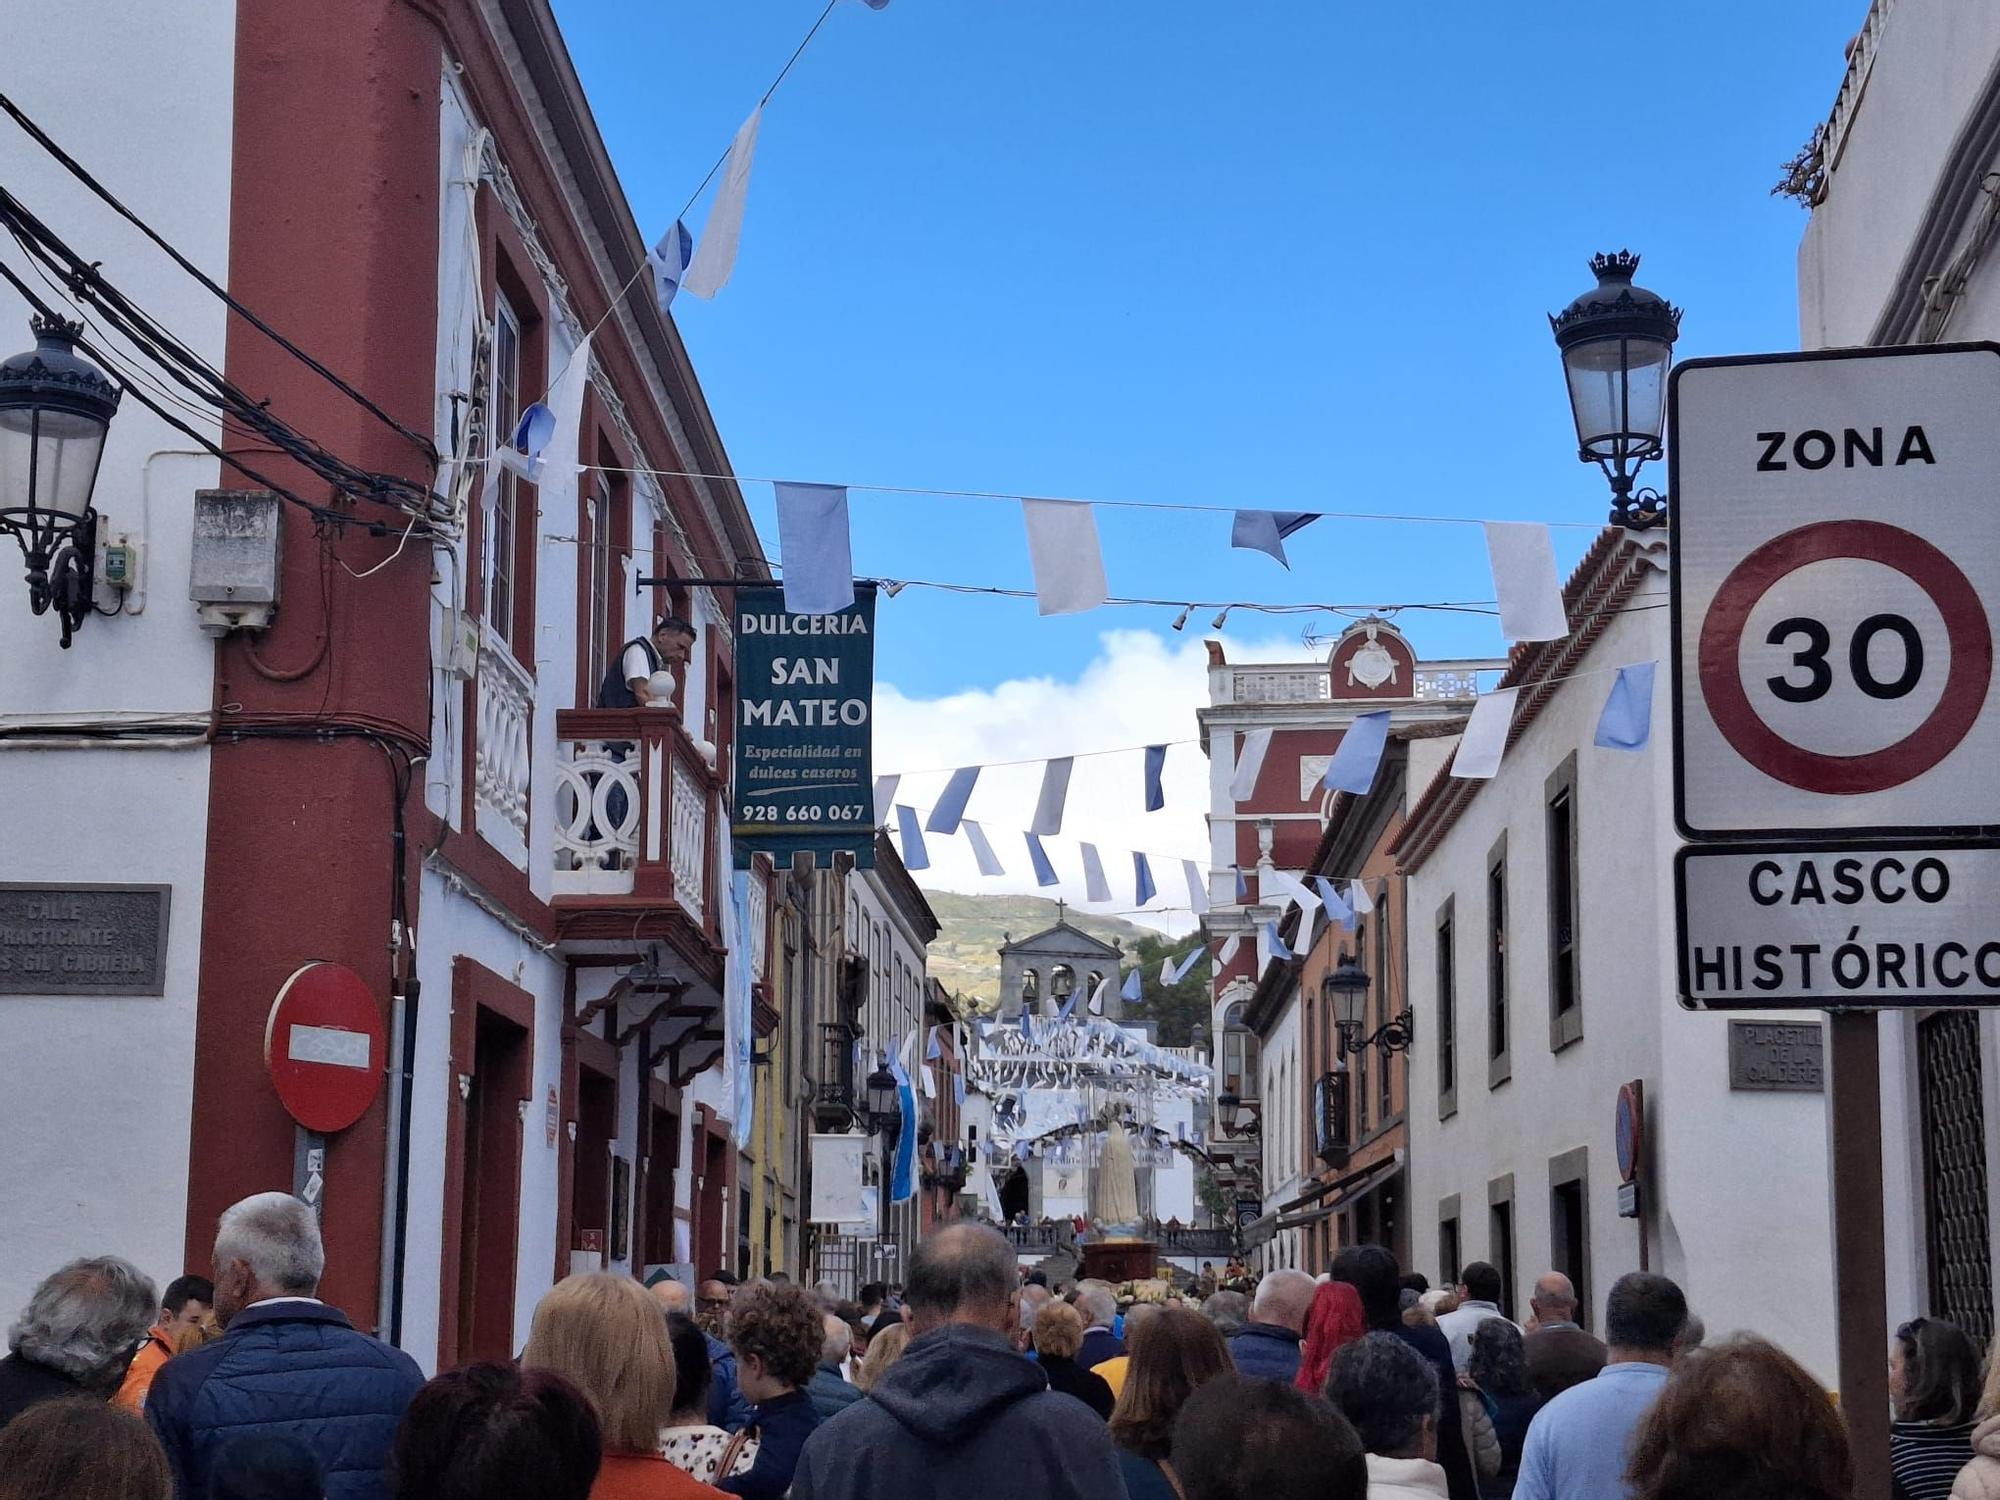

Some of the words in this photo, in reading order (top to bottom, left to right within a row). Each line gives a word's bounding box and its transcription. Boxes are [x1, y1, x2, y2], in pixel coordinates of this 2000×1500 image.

[1756, 424, 1936, 472] ZONA
[741, 613, 868, 635] DULCERIA
[1765, 613, 1925, 704] 30
[771, 657, 840, 685] SAN
[741, 699, 868, 727] MATEO
[744, 744, 841, 761] Especialidad
[843, 748, 862, 758] en
[749, 766, 797, 779] dulces
[801, 767, 857, 779] caseros
[742, 805, 778, 821] 928
[785, 805, 822, 821] 660
[828, 804, 864, 821] 067
[1748, 857, 1951, 906] CASCO
[28, 902, 80, 920] CALLE
[1694, 925, 2000, 991] HISTÓRICO
[1744, 1027, 1822, 1044] PLACETILL
[1771, 1047, 1789, 1063] DE
